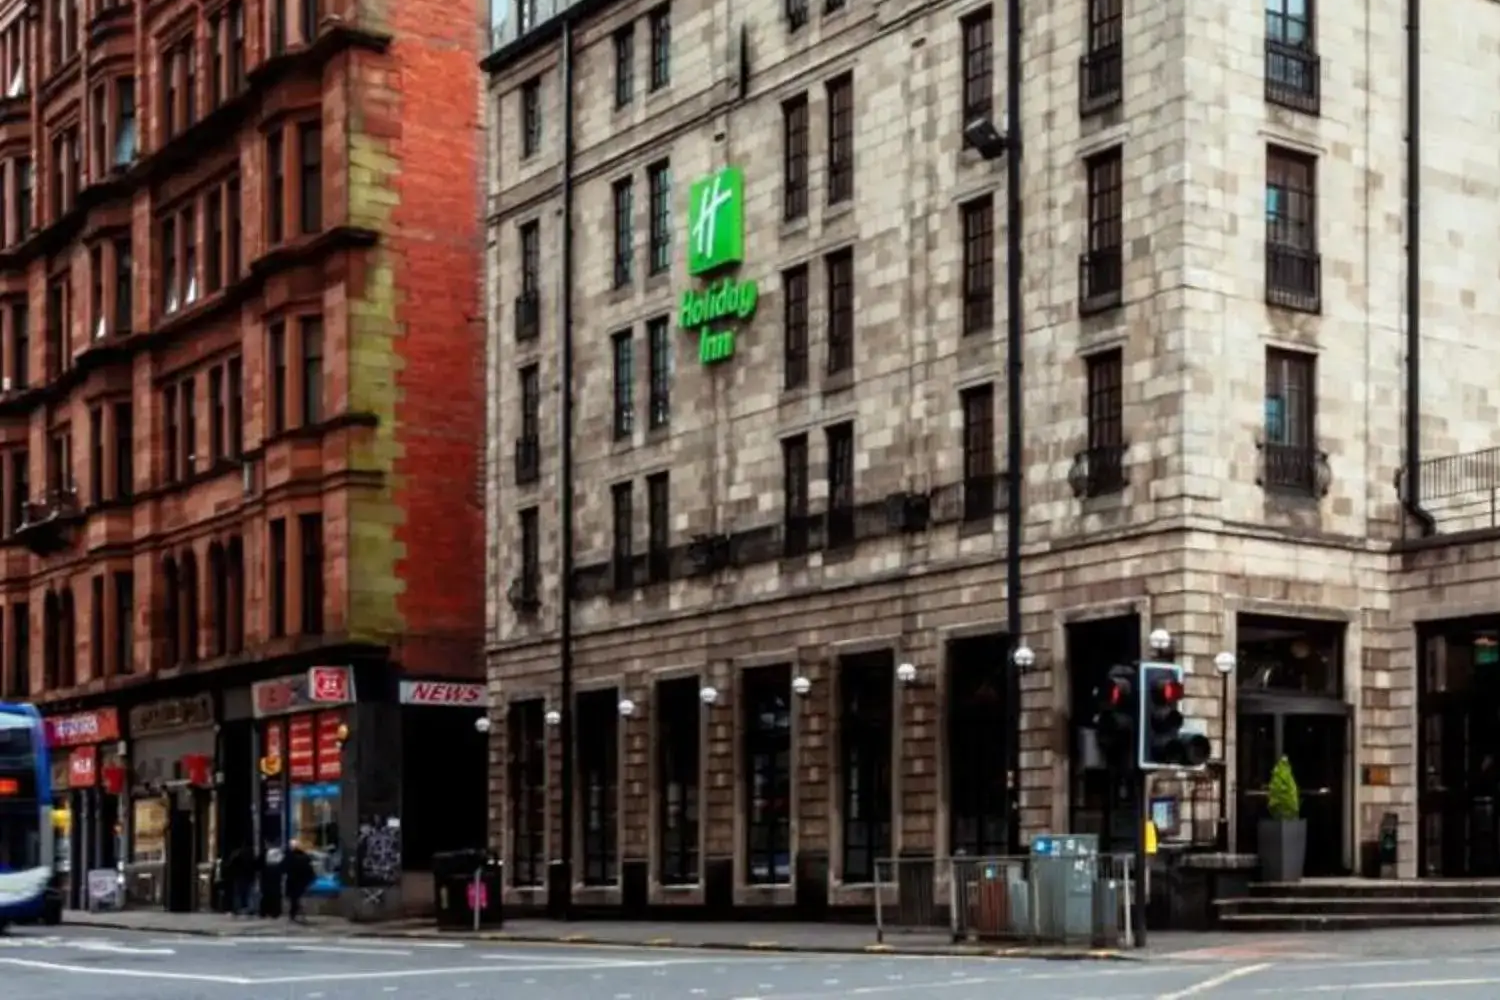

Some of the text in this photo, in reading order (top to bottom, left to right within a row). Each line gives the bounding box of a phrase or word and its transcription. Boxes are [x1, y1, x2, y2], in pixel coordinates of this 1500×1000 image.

[679, 277, 758, 328] Holiday
[700, 325, 735, 364] Inn
[412, 682, 480, 702] NEWS
